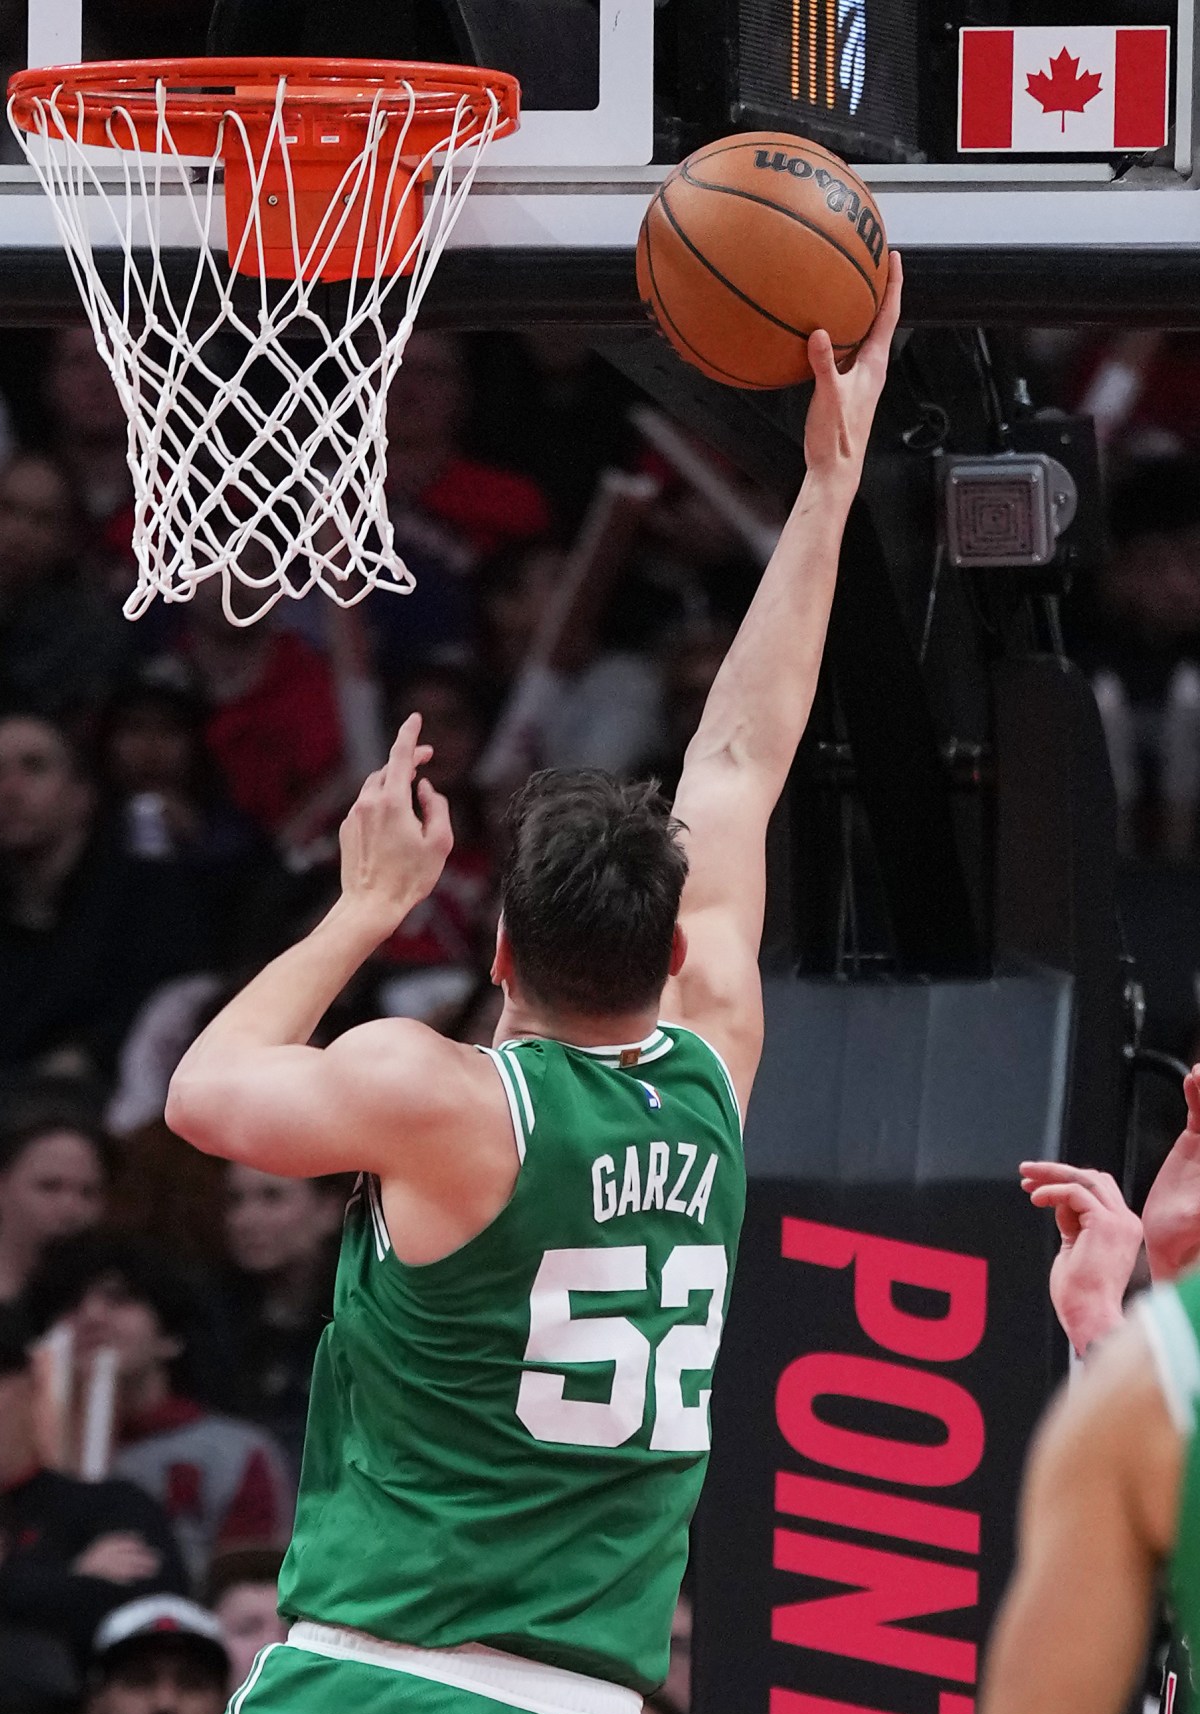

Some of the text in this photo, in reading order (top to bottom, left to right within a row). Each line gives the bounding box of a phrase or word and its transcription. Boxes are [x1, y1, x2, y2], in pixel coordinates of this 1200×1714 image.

[753, 149, 885, 271] Wilson
[591, 1140, 719, 1226] GARZA
[515, 1244, 728, 1452] 52
